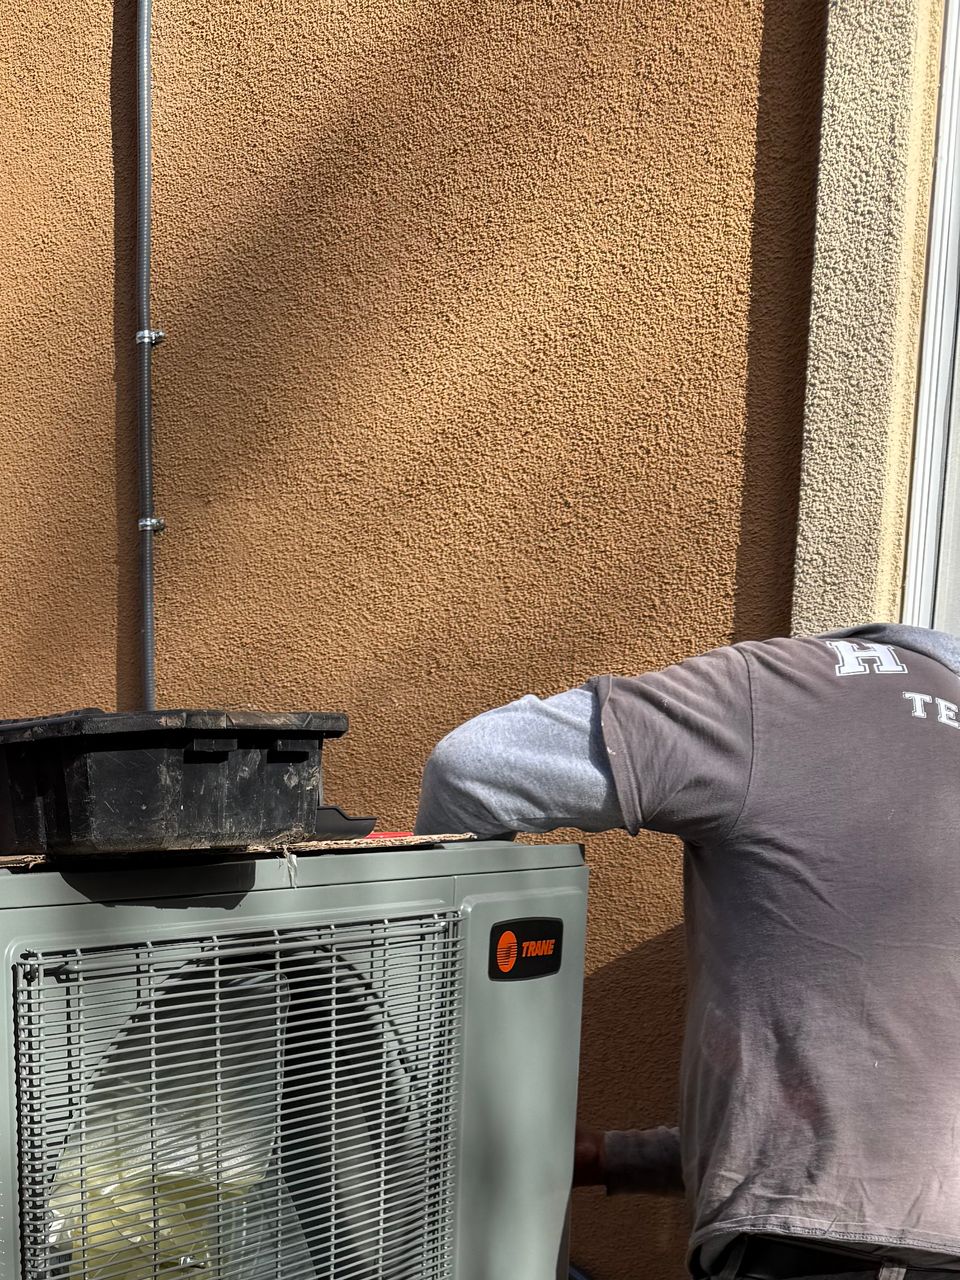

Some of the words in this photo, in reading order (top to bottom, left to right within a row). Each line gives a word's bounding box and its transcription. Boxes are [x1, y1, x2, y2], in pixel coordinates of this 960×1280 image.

[826, 641, 908, 676] H
[902, 691, 960, 729] TE
[521, 939, 556, 957] TRANE
